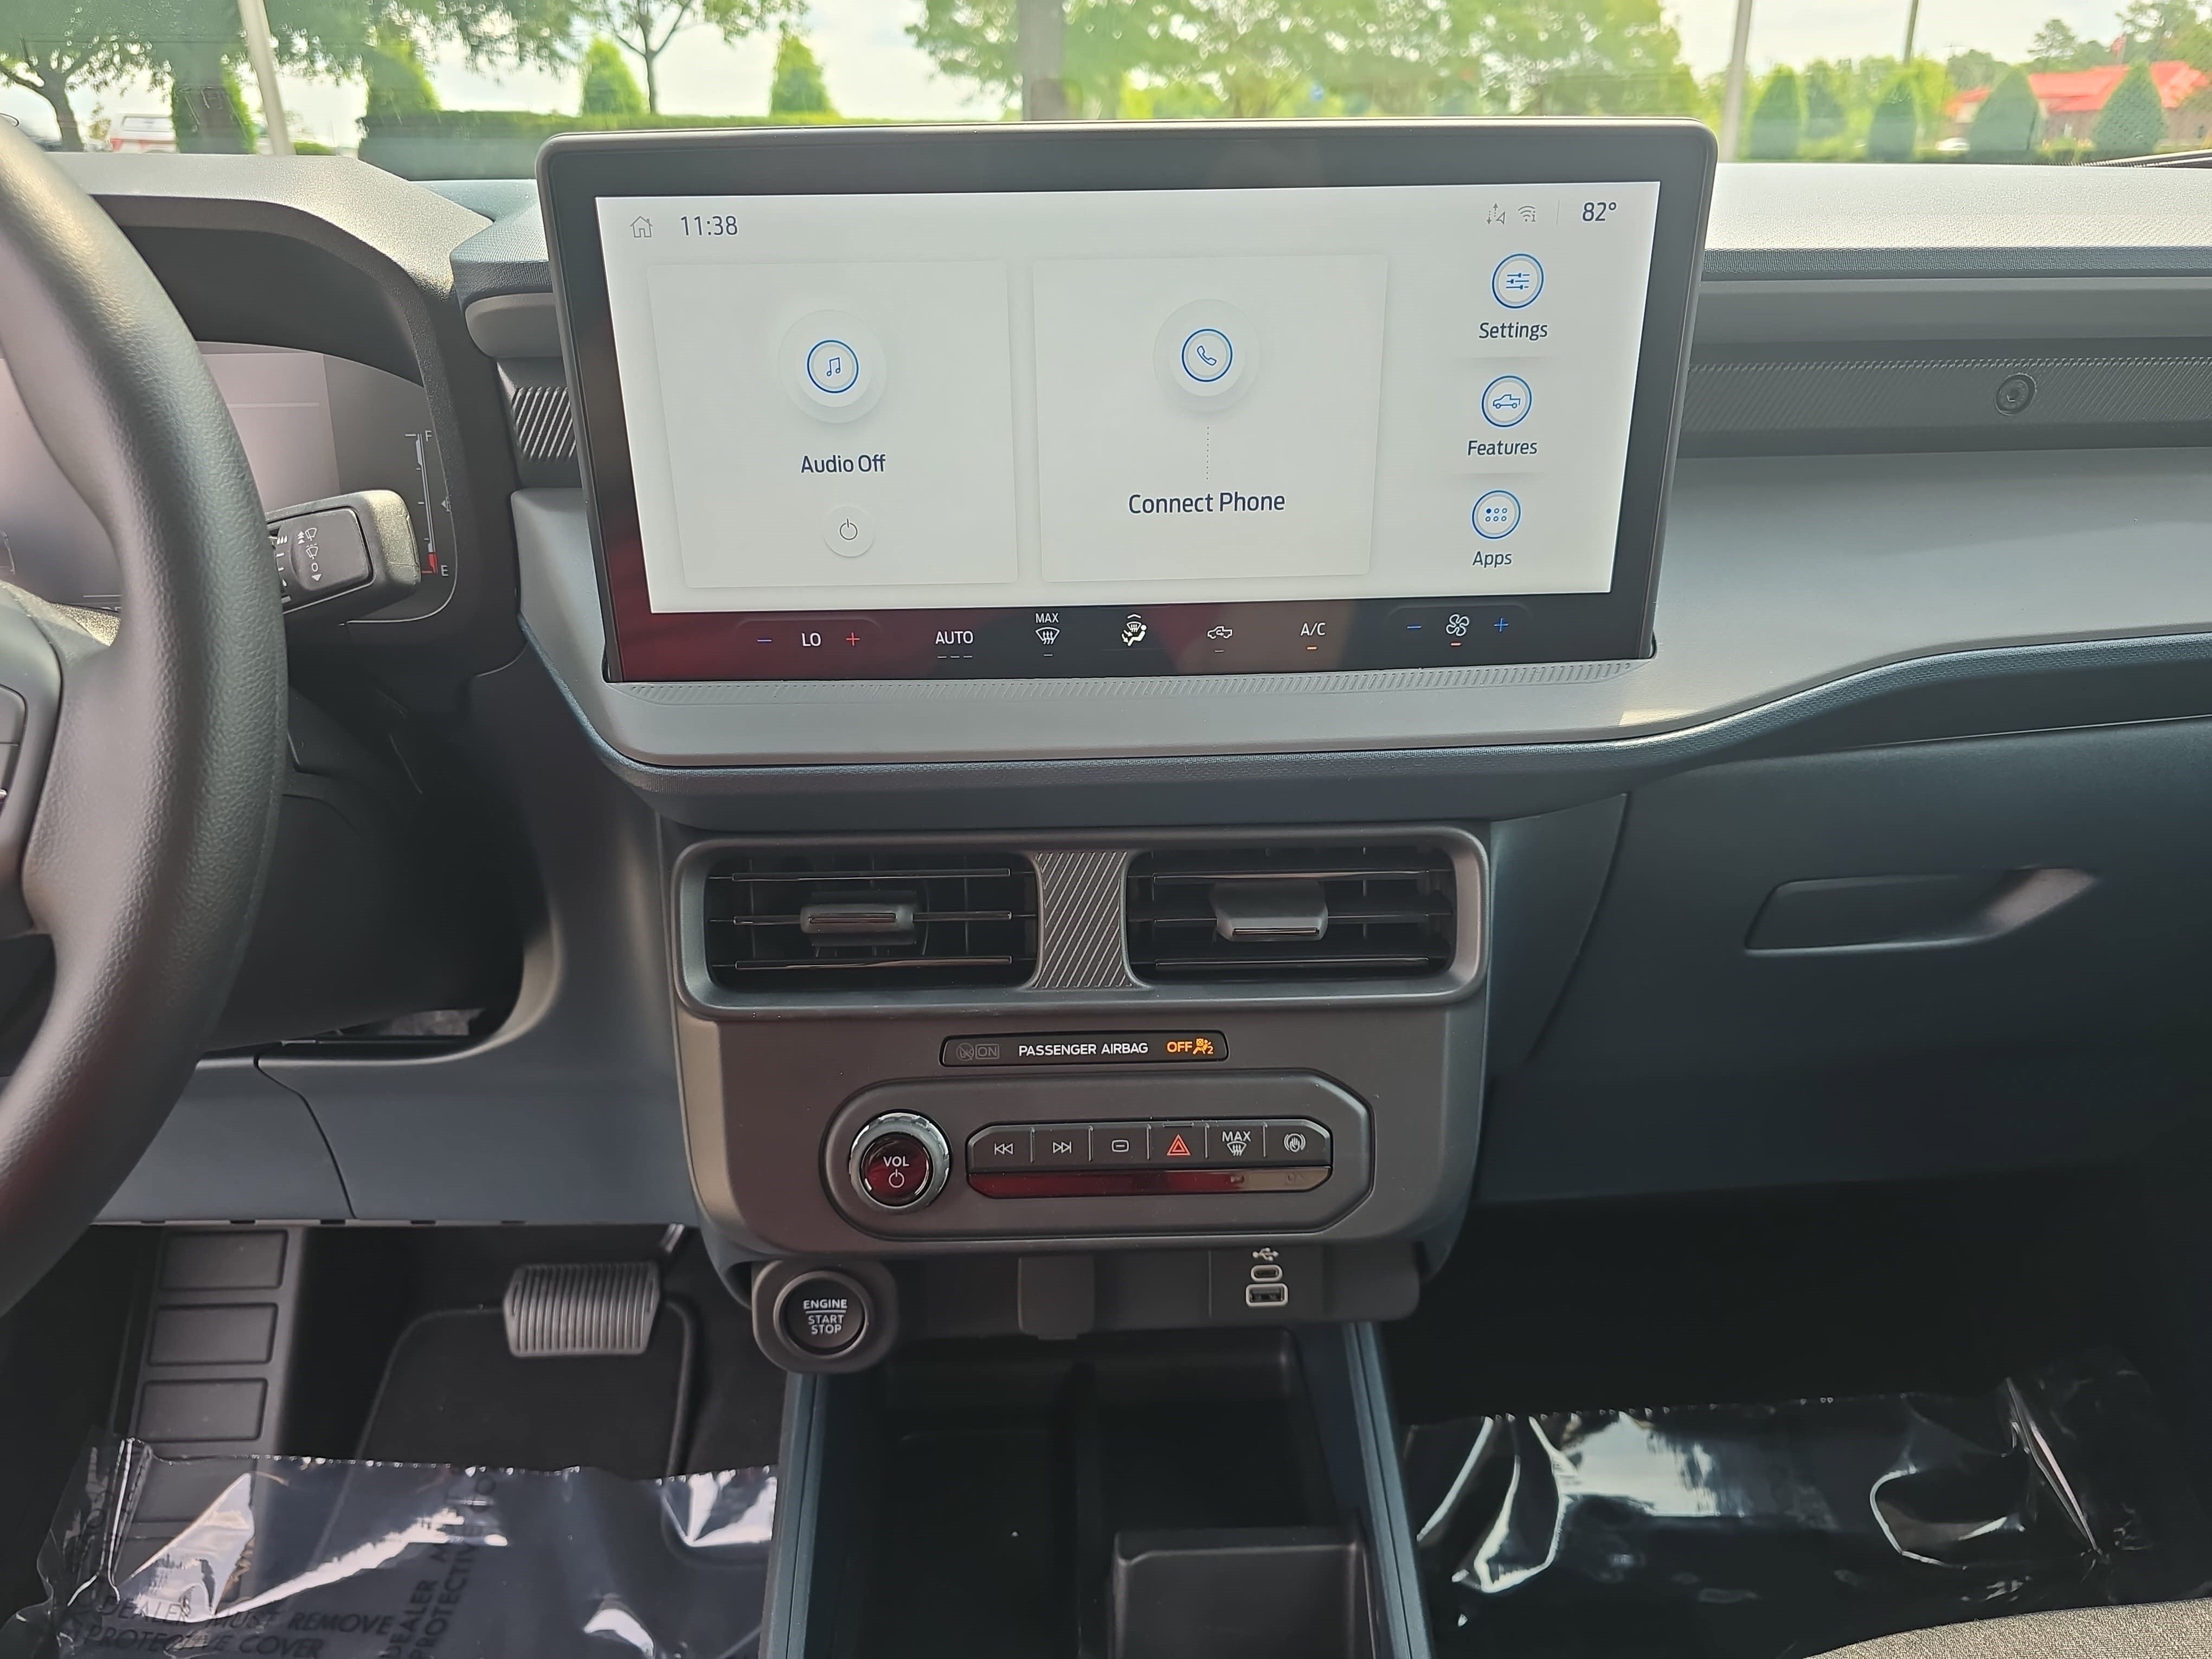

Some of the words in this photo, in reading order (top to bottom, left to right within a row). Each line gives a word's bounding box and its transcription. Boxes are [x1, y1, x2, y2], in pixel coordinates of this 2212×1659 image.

[1581, 201, 1617, 222] 82°
[679, 215, 739, 237] 11:38
[1478, 321, 1548, 341] Settings
[425, 430, 433, 442] F
[1467, 440, 1538, 456] Features
[800, 454, 854, 473] Audio
[858, 454, 886, 472] Off
[1128, 493, 1214, 514] Connect
[1219, 491, 1285, 512] Phone
[1471, 550, 1513, 569] Apps
[440, 564, 449, 577] E
[1035, 612, 1059, 624] MAX
[1300, 621, 1327, 636] A/C
[801, 632, 822, 647] LO
[935, 630, 974, 646] AUTO
[977, 1046, 998, 1057] ON
[1018, 1044, 1097, 1057] PASSENGER
[1101, 1042, 1149, 1054] AIRBAG
[1166, 1041, 1193, 1053] OFF
[1221, 1130, 1252, 1142] MAX
[883, 1156, 910, 1167] VOL
[803, 1298, 848, 1310] ENGINE
[808, 1314, 845, 1325] START
[811, 1323, 842, 1335] STOP
[287, 1611, 395, 1635] REMOVE
[239, 1634, 325, 1659] COVER
